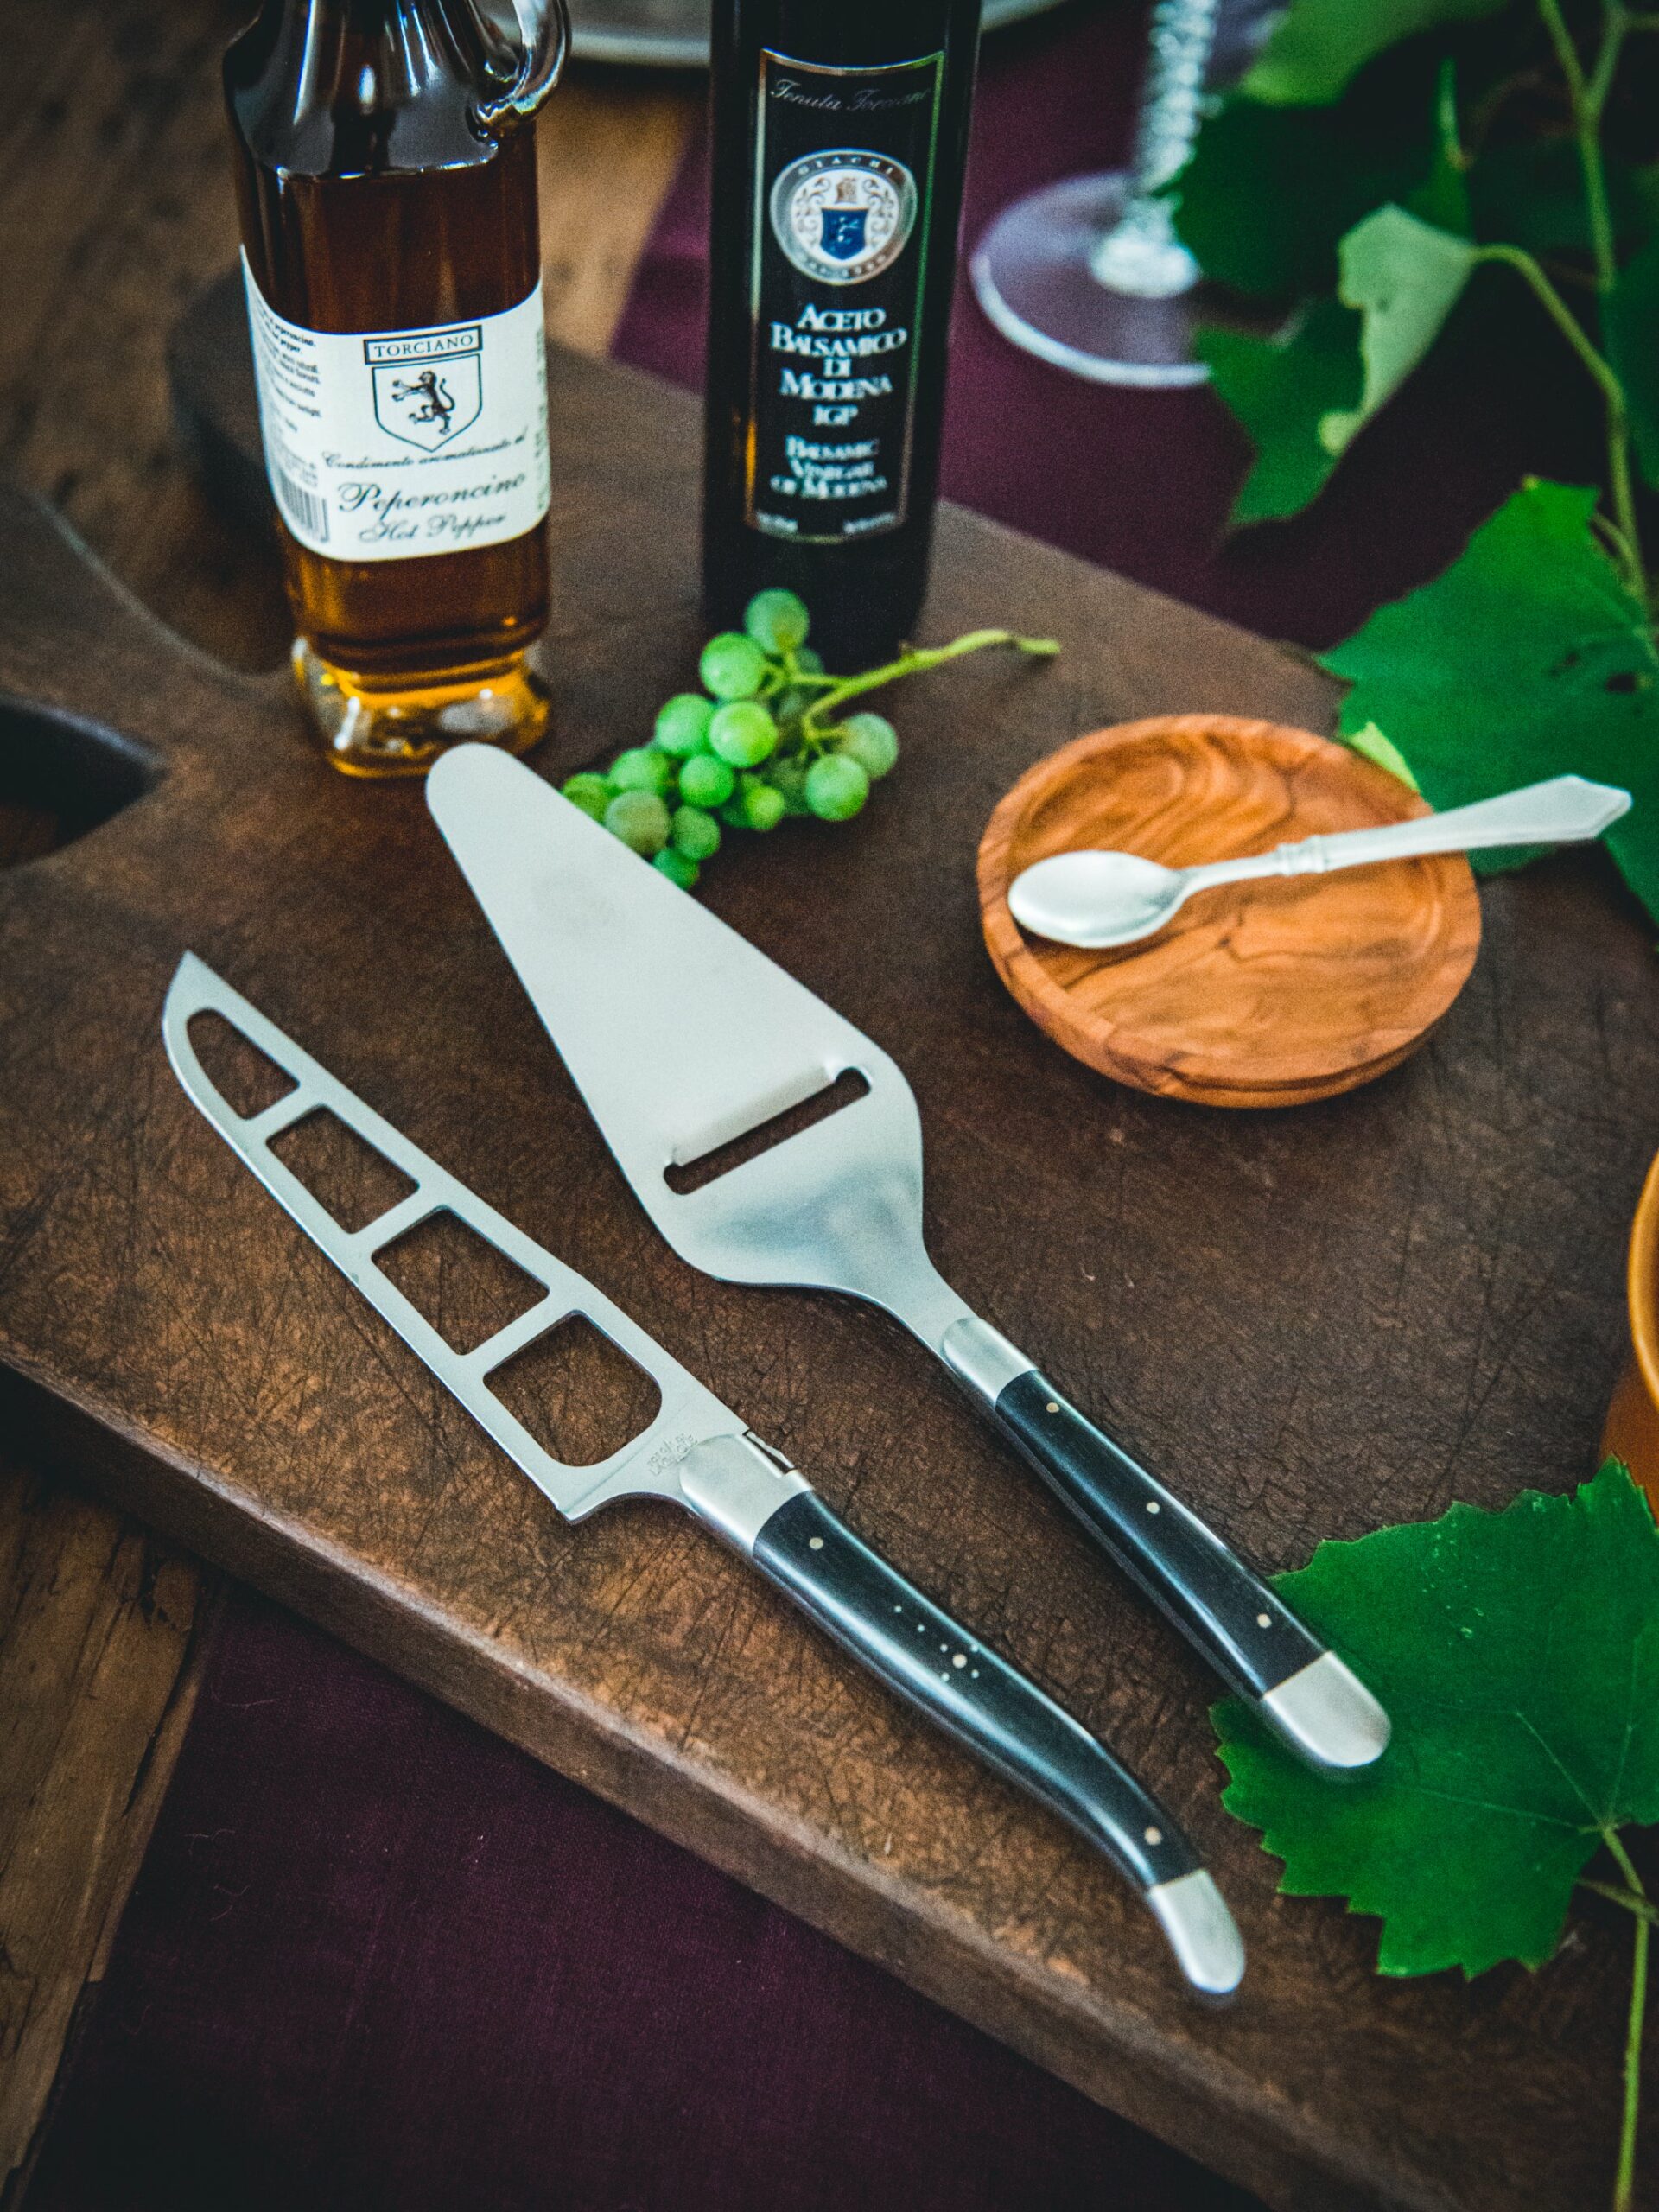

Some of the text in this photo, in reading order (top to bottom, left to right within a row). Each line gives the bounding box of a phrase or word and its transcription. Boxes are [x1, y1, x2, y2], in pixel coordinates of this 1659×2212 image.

[770, 78, 843, 111] Tenuta
[374, 334, 474, 359] TORCIANO
[823, 357, 853, 378] DI
[337, 473, 526, 520] Peperoncino
[359, 513, 506, 543] Hot Pepper
